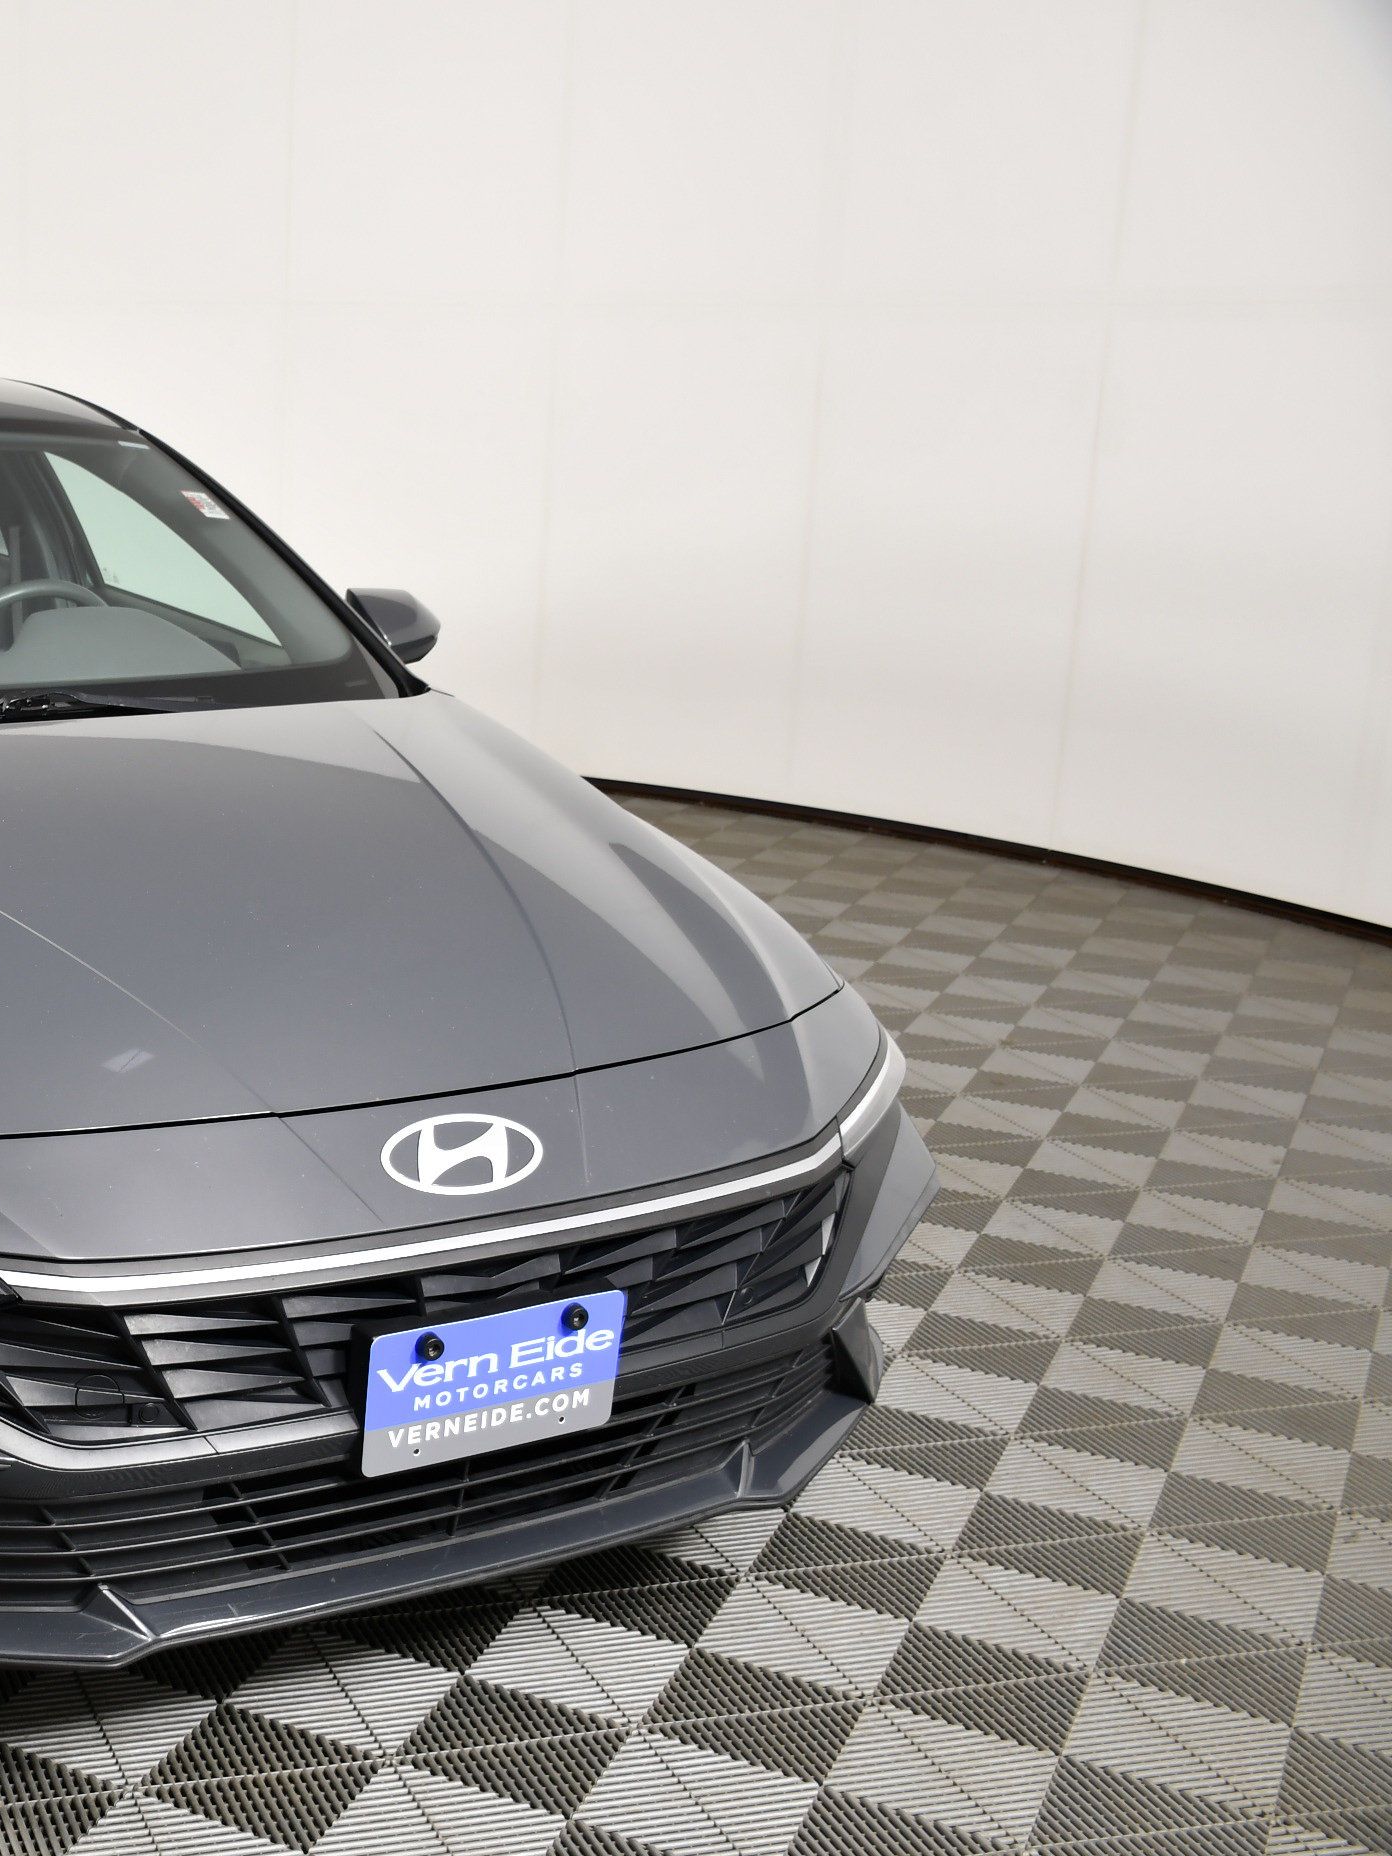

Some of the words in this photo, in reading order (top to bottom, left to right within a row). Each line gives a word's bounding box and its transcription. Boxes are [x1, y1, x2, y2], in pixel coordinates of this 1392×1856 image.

[377, 1351, 499, 1393] Vern
[508, 1328, 614, 1369] Eide
[413, 1362, 583, 1412] MOTORCARS
[387, 1388, 591, 1449] VERNEIDE.COM
